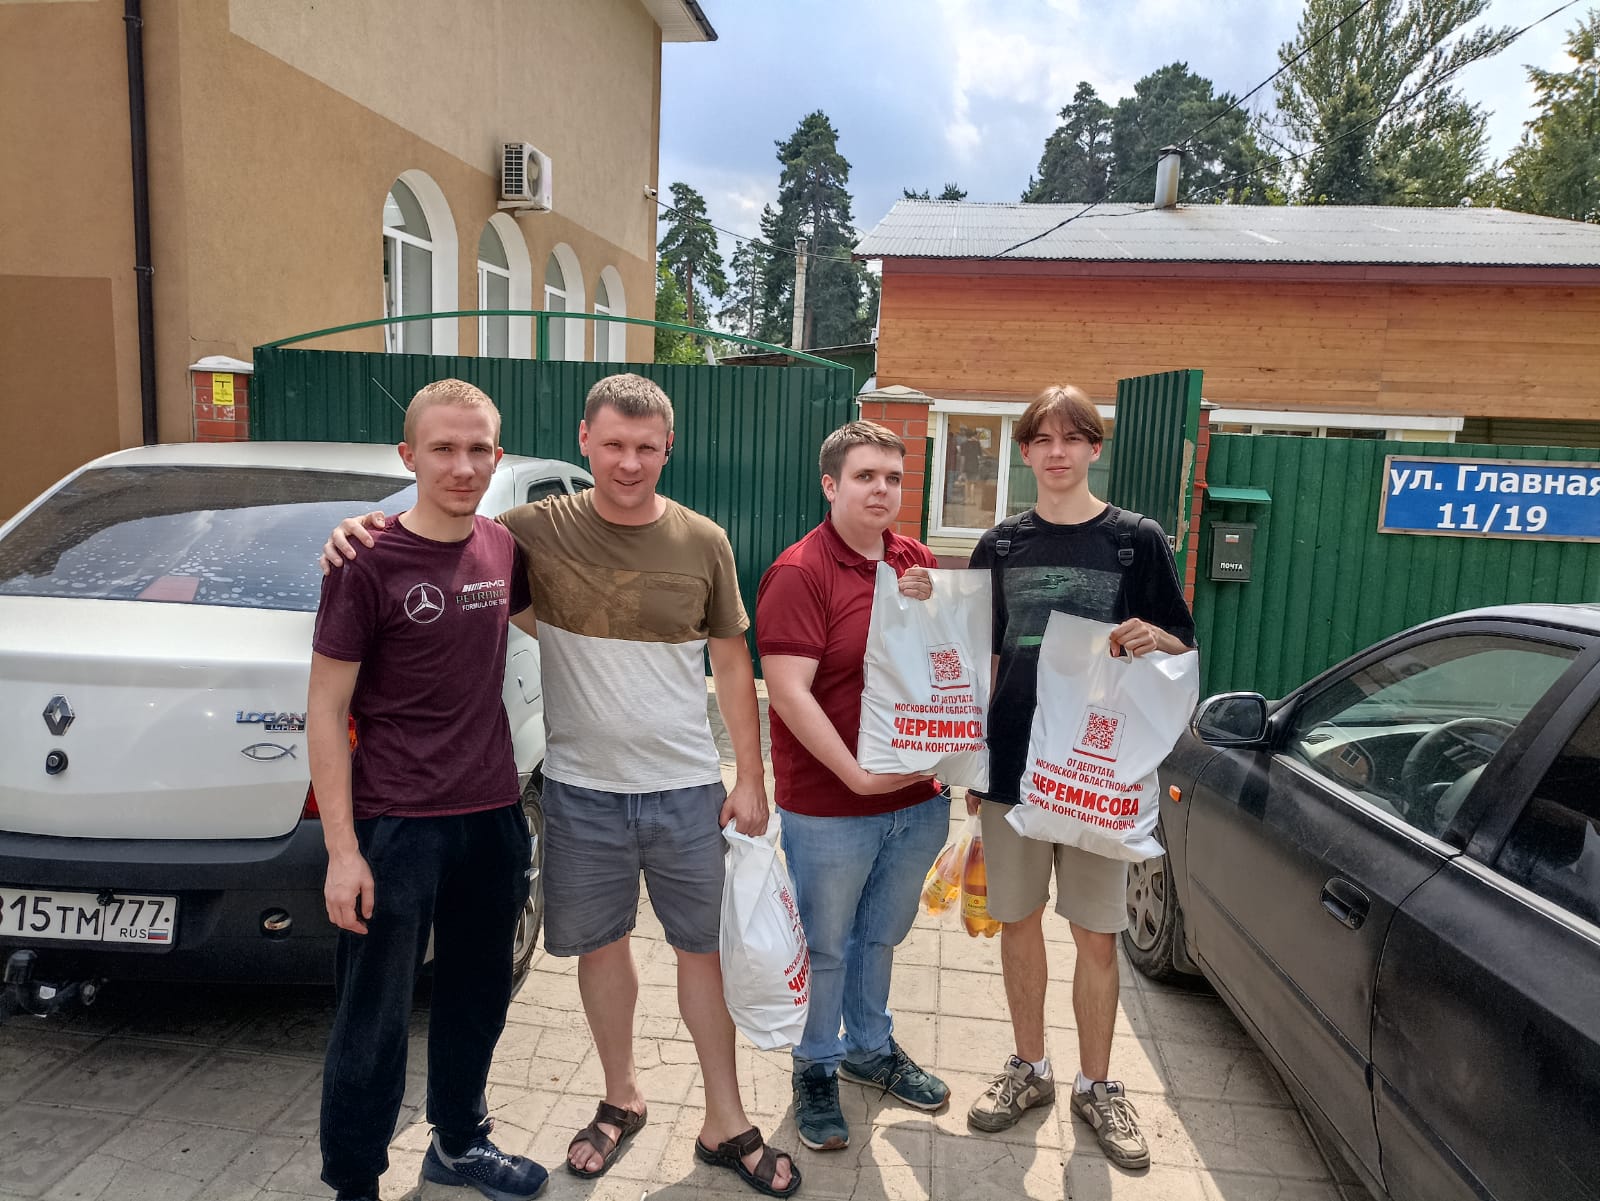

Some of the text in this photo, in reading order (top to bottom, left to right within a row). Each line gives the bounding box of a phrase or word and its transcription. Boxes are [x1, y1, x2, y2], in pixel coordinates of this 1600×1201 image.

[1390, 465, 1600, 496] ул. Главная
[1437, 503, 1548, 533] 11/19
[1220, 562, 1243, 570] ПОЧТА
[478, 579, 505, 589] AMG
[462, 601, 488, 611] FORMULA
[931, 694, 939, 703] ОТ
[895, 703, 944, 714] МОСКОВСКОЙ
[235, 711, 307, 724] LOGAN
[891, 738, 923, 751] МАРКА
[1066, 758, 1115, 778] ОТ ДЕПУТАТА
[1032, 772, 1139, 816] ЧЕРЕМИСОВА
[1052, 803, 1136, 830] КОНСТАНТИНОВИЧА
[110, 899, 165, 928] 777
[120, 928, 147, 939] RUS
